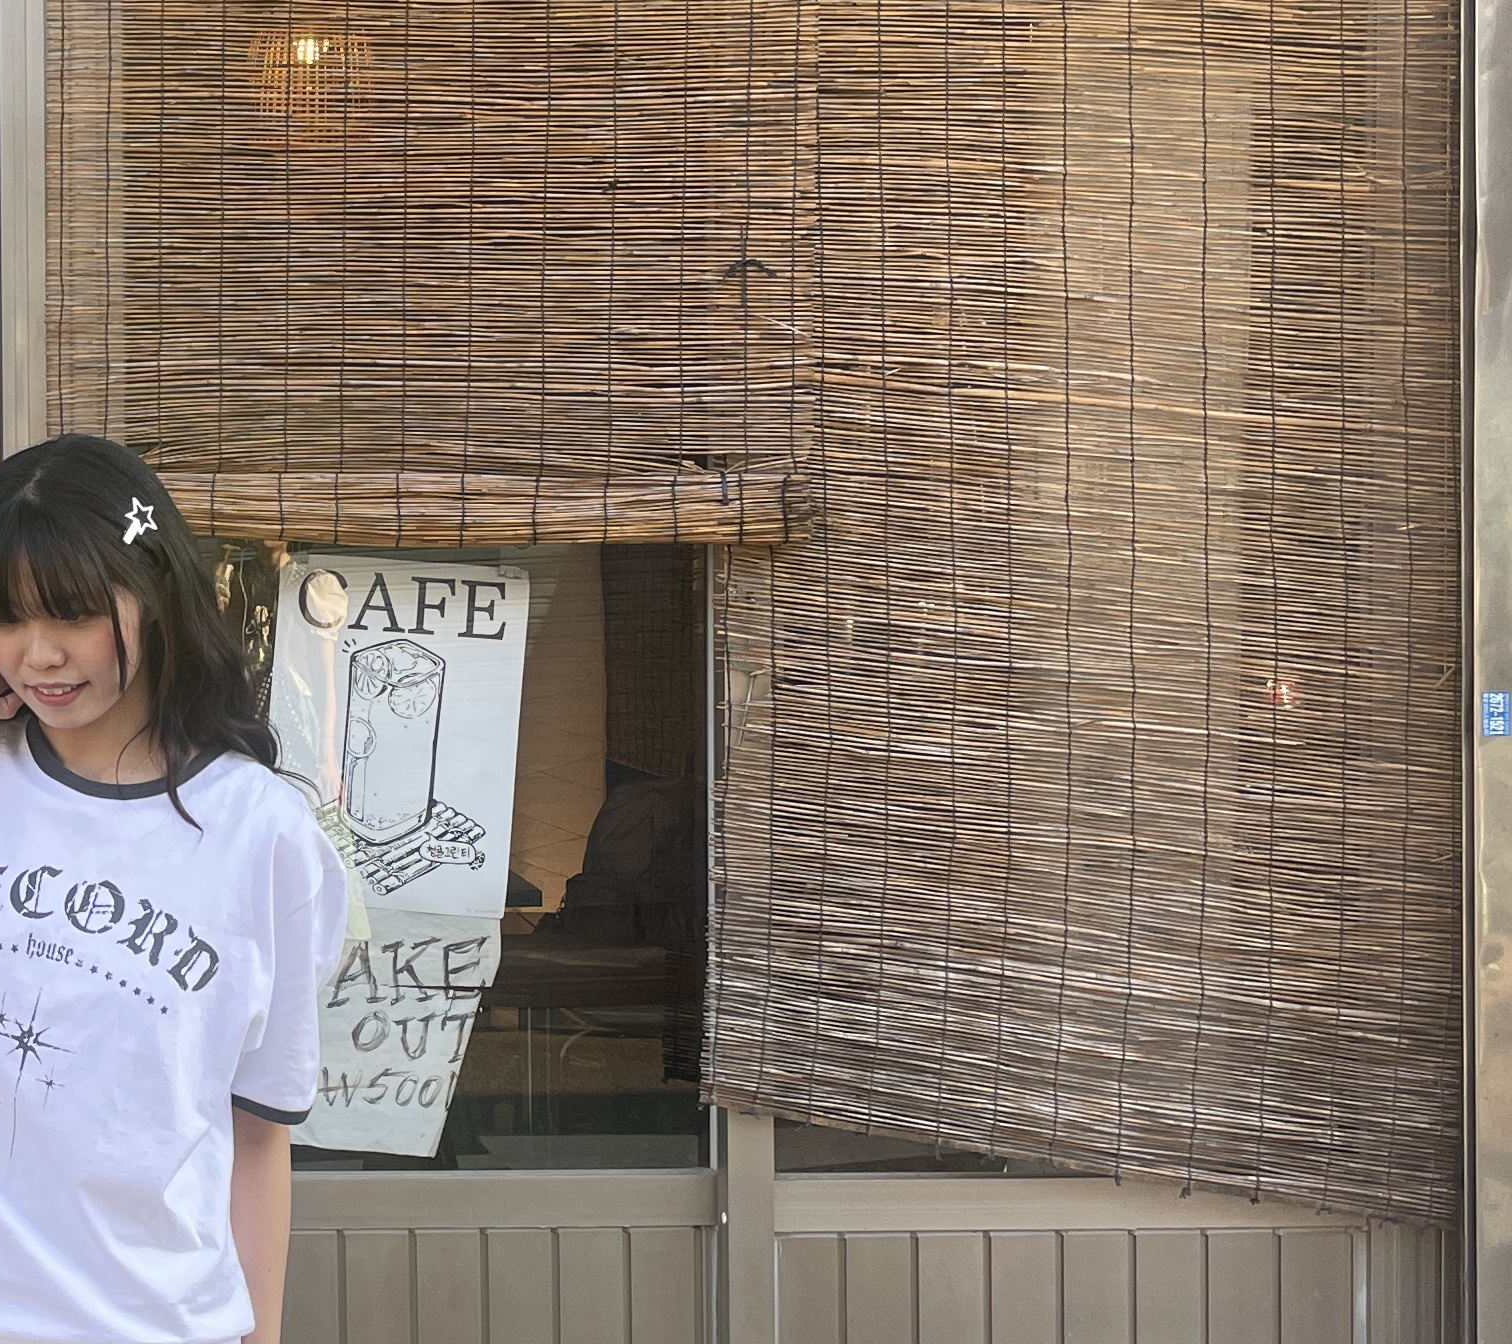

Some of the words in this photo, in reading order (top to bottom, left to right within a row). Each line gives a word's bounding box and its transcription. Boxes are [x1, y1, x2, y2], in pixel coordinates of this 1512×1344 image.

[298, 568, 507, 640] CAFE
[26, 932, 73, 964] house
[326, 934, 491, 1008] AKE
[352, 1009, 476, 1063] OUT
